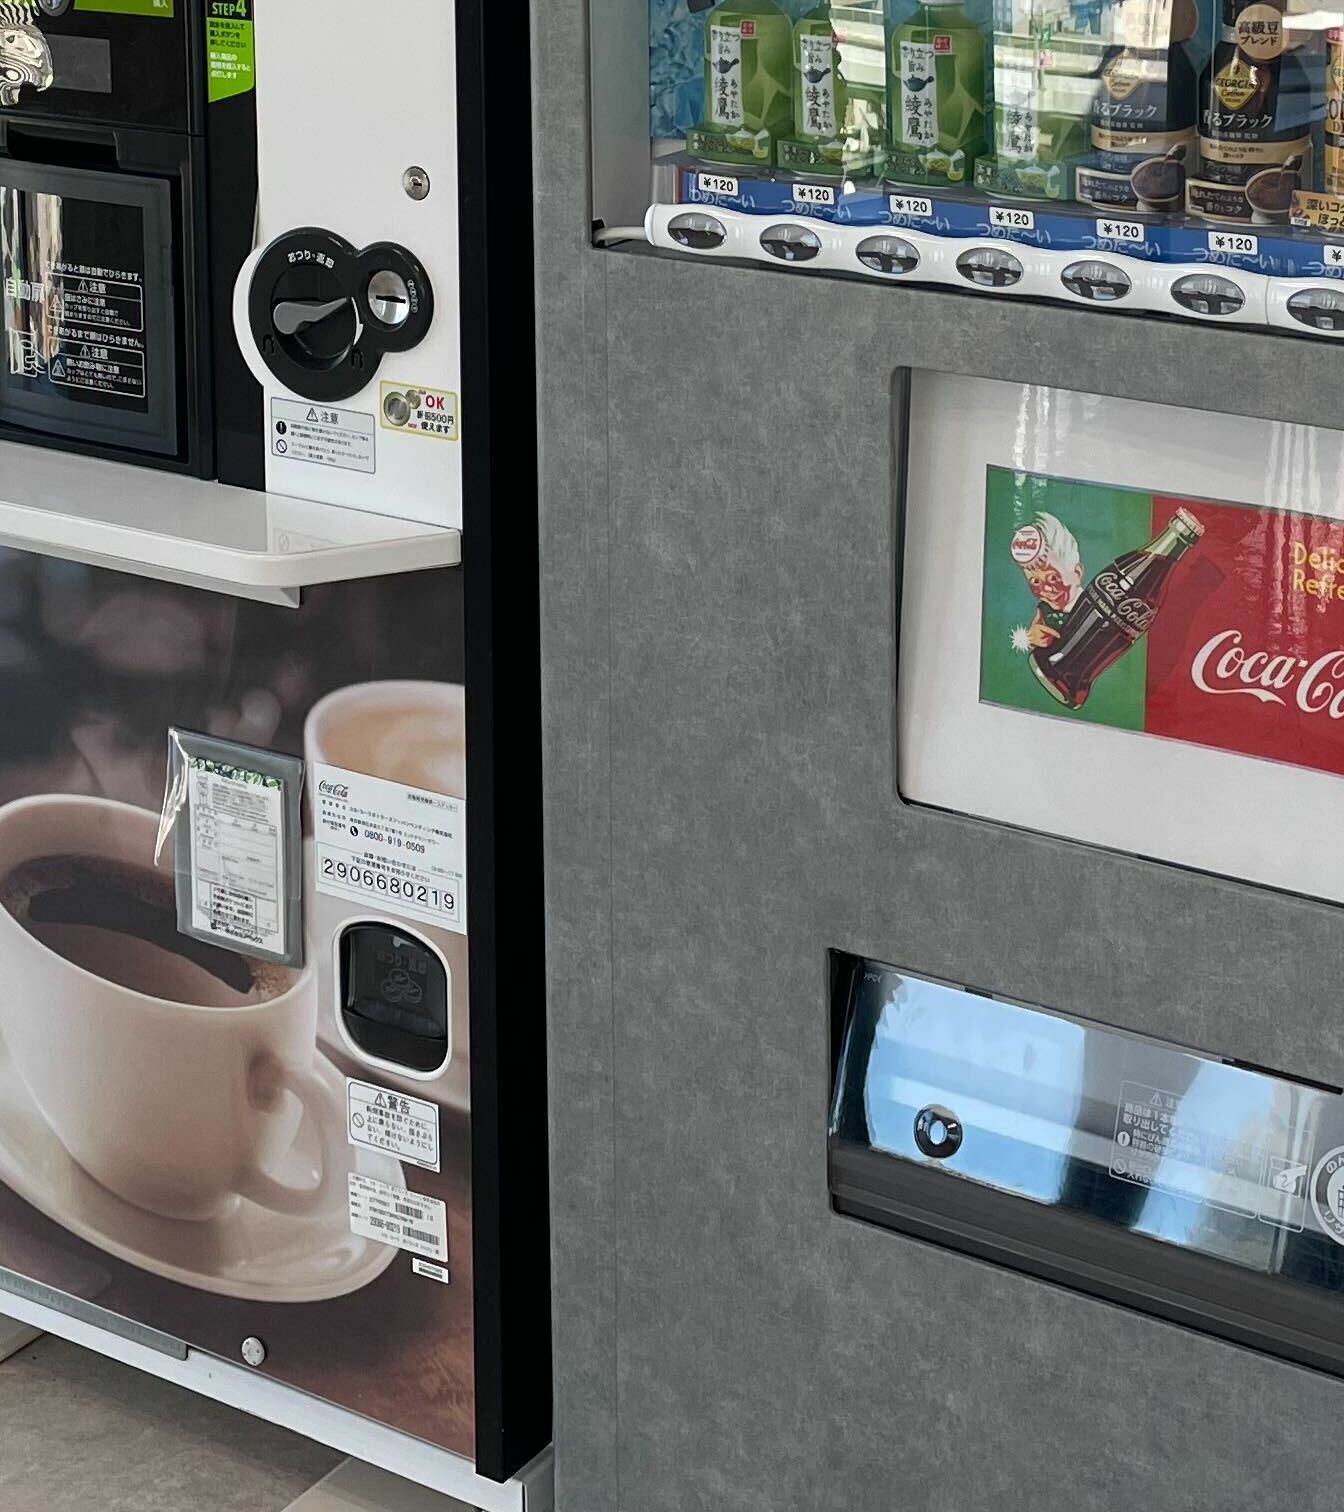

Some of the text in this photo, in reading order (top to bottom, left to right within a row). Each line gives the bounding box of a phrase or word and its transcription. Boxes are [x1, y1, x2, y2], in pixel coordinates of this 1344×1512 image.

[1238, 21, 1279, 35] 高級豆
[1240, 36, 1278, 47] ブレンド
[703, 178, 734, 191] ¥120
[1215, 236, 1253, 251] ¥120
[426, 394, 444, 410] OK
[387, 1095, 411, 1114] 警告
